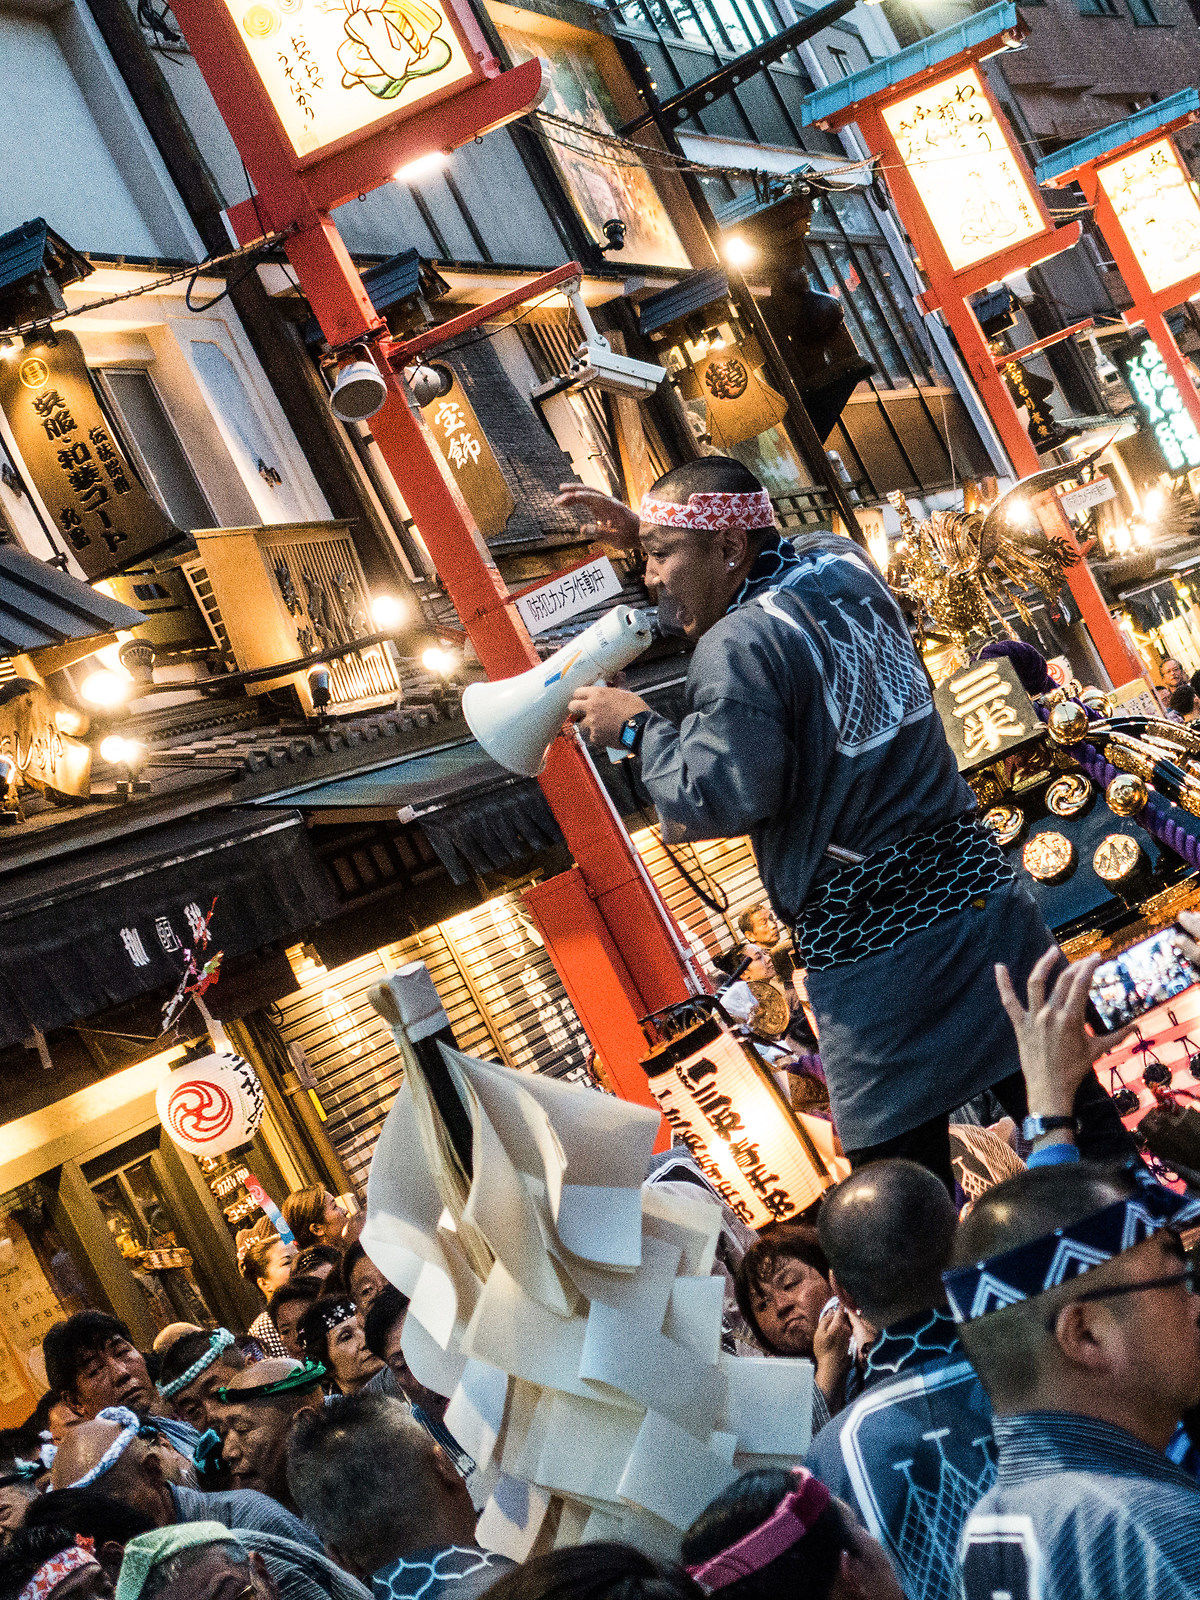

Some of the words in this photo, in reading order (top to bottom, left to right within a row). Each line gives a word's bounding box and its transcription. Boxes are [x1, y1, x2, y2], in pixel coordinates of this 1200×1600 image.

[434, 402, 481, 470] 宝飾
[526, 566, 605, 622] 防犯カメラ作動中
